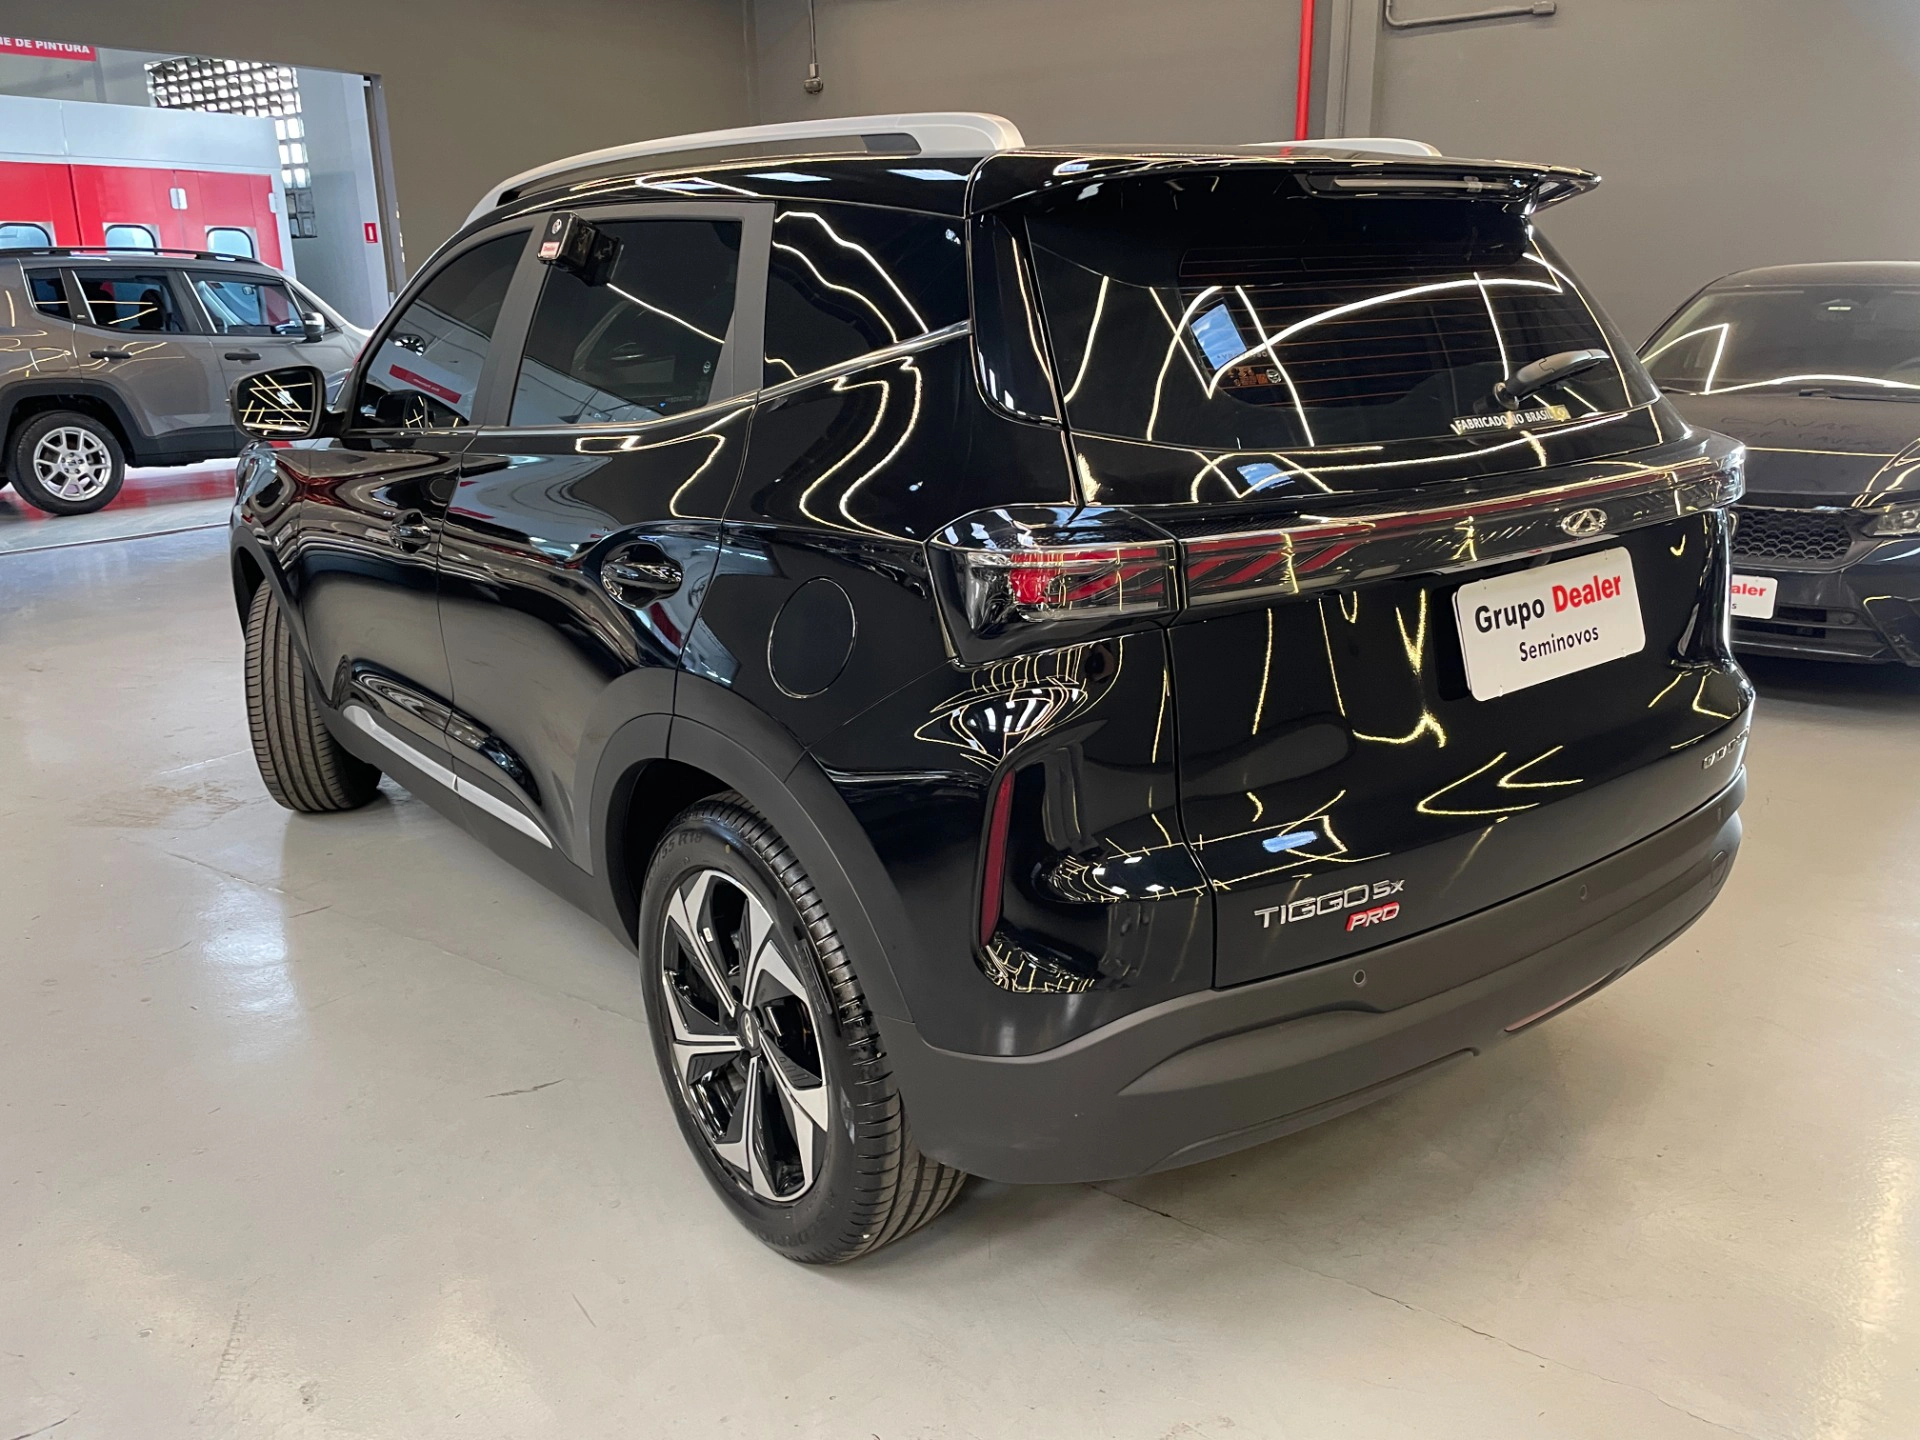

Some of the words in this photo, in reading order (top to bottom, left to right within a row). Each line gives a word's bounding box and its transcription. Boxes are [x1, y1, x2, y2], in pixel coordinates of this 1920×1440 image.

[15, 38, 32, 48] DE
[35, 40, 90, 54] PINTURA
[1454, 416, 1508, 431] FABRICADO
[1525, 409, 1553, 422] BRASIL
[1475, 598, 1545, 633] Grupo
[1552, 575, 1621, 613] Dealer
[1731, 583, 1767, 597] aler
[1519, 627, 1599, 662] Seminovos
[1254, 884, 1369, 929] TIGGO
[1346, 901, 1400, 932] PRO
